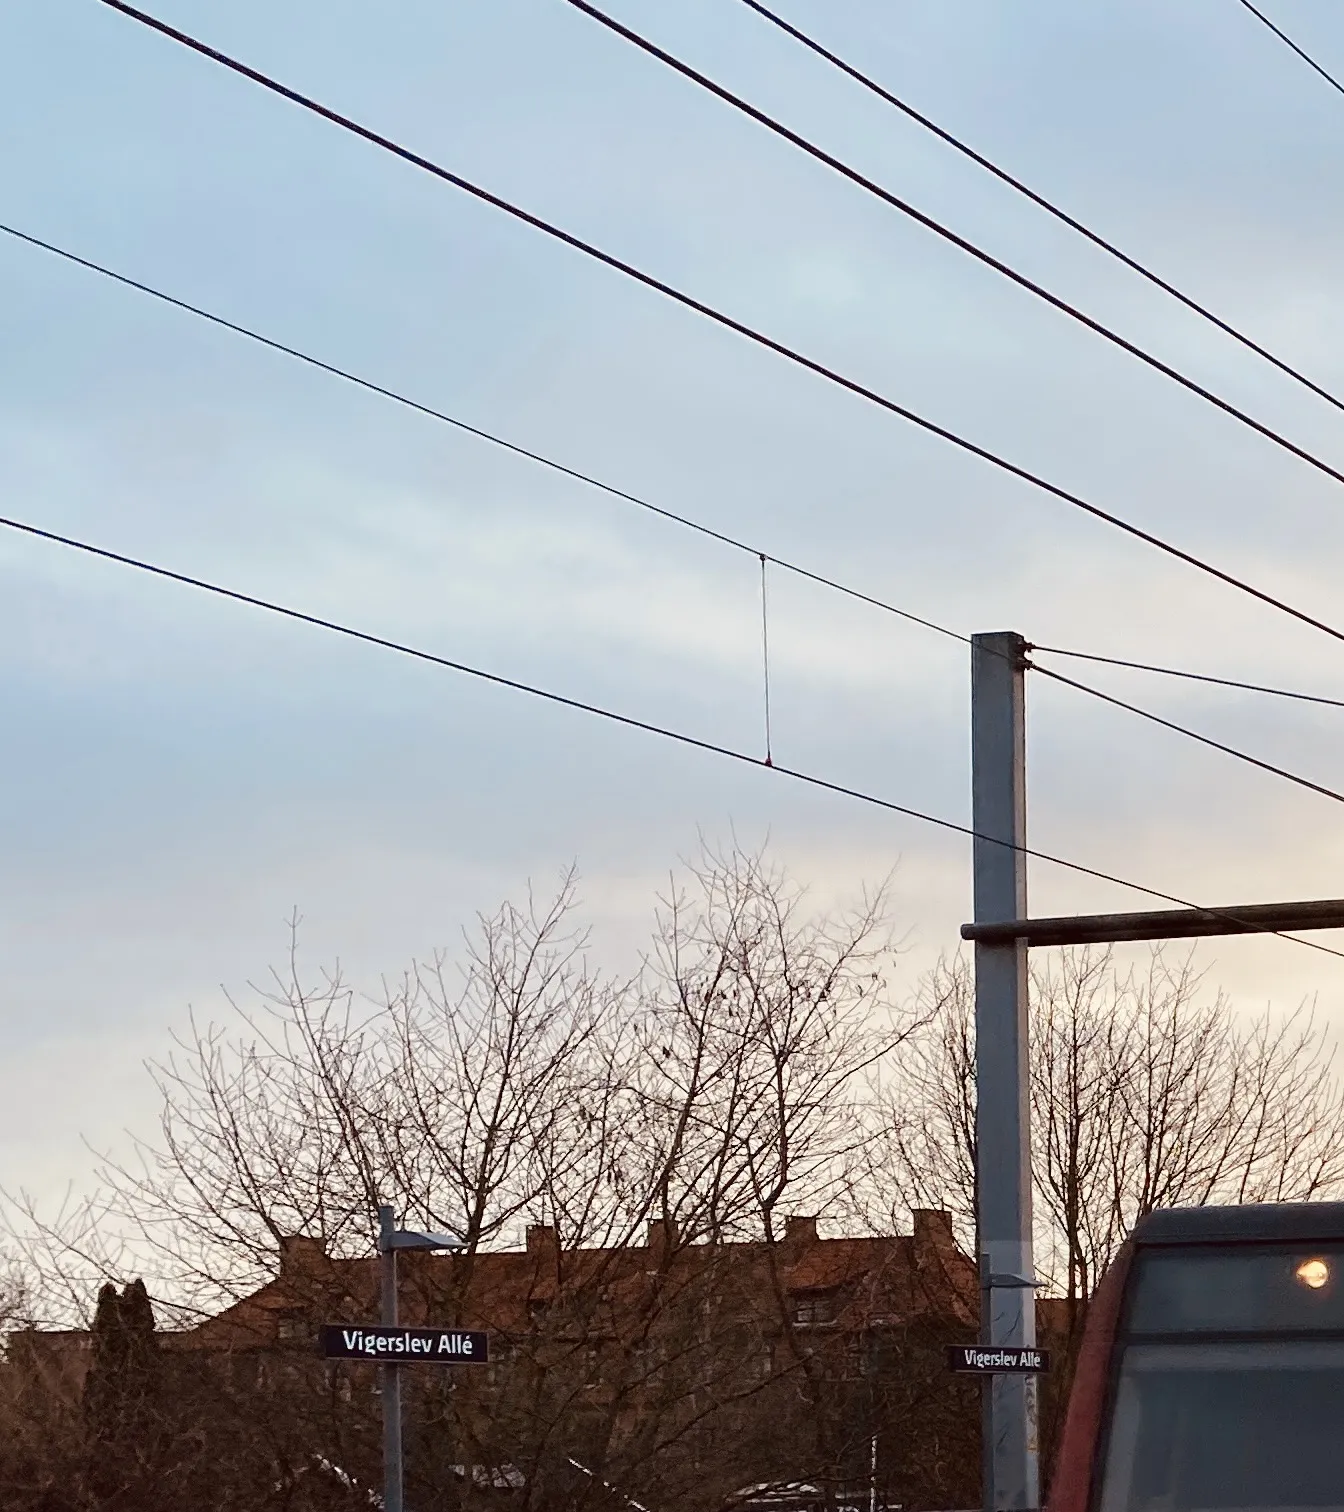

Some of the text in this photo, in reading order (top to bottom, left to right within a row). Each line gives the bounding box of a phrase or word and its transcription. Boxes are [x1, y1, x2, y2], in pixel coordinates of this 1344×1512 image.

[342, 1330, 473, 1355] Vigerslev Allé
[964, 1349, 1041, 1369] Vigerslev Allé
